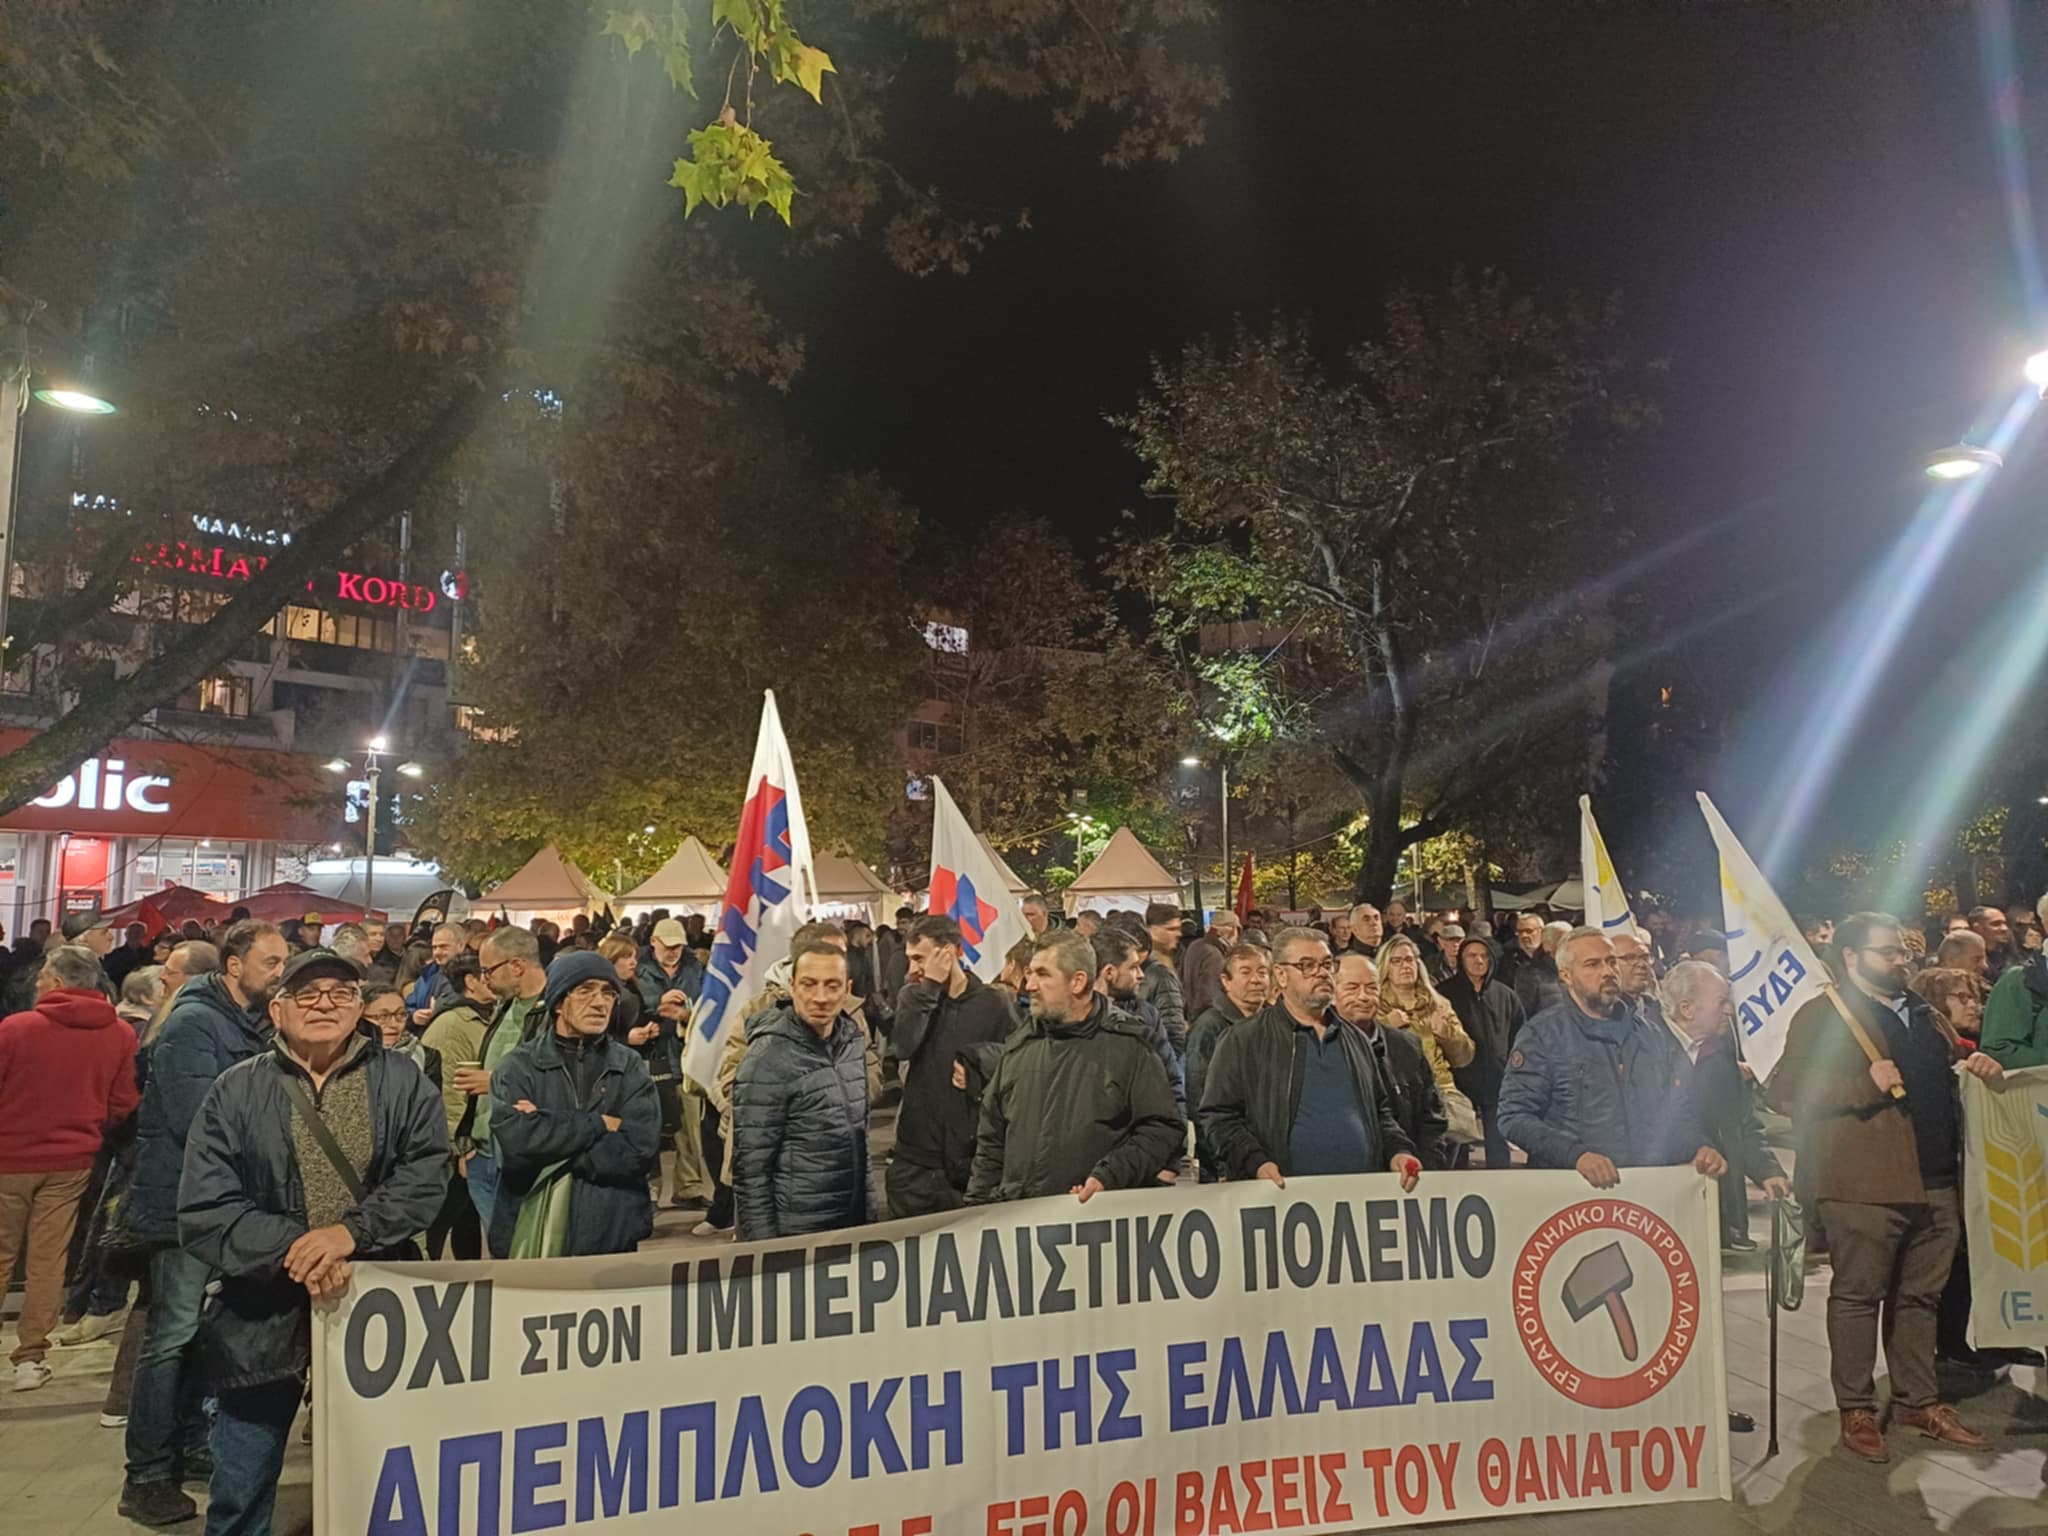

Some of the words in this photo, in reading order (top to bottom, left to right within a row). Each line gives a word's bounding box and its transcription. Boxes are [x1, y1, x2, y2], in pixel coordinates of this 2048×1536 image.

[1612, 1205, 1684, 1266] ΚΕΝΤΡΟ
[344, 1279, 494, 1398] ΟΧΙ
[521, 1305, 642, 1375] ΣΤΟΝ
[669, 1206, 1220, 1357] ΙΜΠΕΡΙΑΛΙΣΤΙΚΟ
[1241, 1194, 1496, 1293] ΠΟΛΕΜΟ
[1643, 1299, 1694, 1389] ΛΑΡΙΣΑΣ
[366, 1370, 963, 1536] ΑΠΕΜΠΛΟΚΗ
[991, 1348, 1143, 1457] ΤΗΣ
[1168, 1318, 1495, 1432] ΕΛΛΑΔΑΣ
[1105, 1477, 1157, 1536] ΟΙ
[1175, 1452, 1354, 1536] ΒΑΣΕΙΣ
[1363, 1438, 1462, 1517] ΤΟΥ
[1477, 1424, 1706, 1507] ΘΑΝΑΤΟΥ
